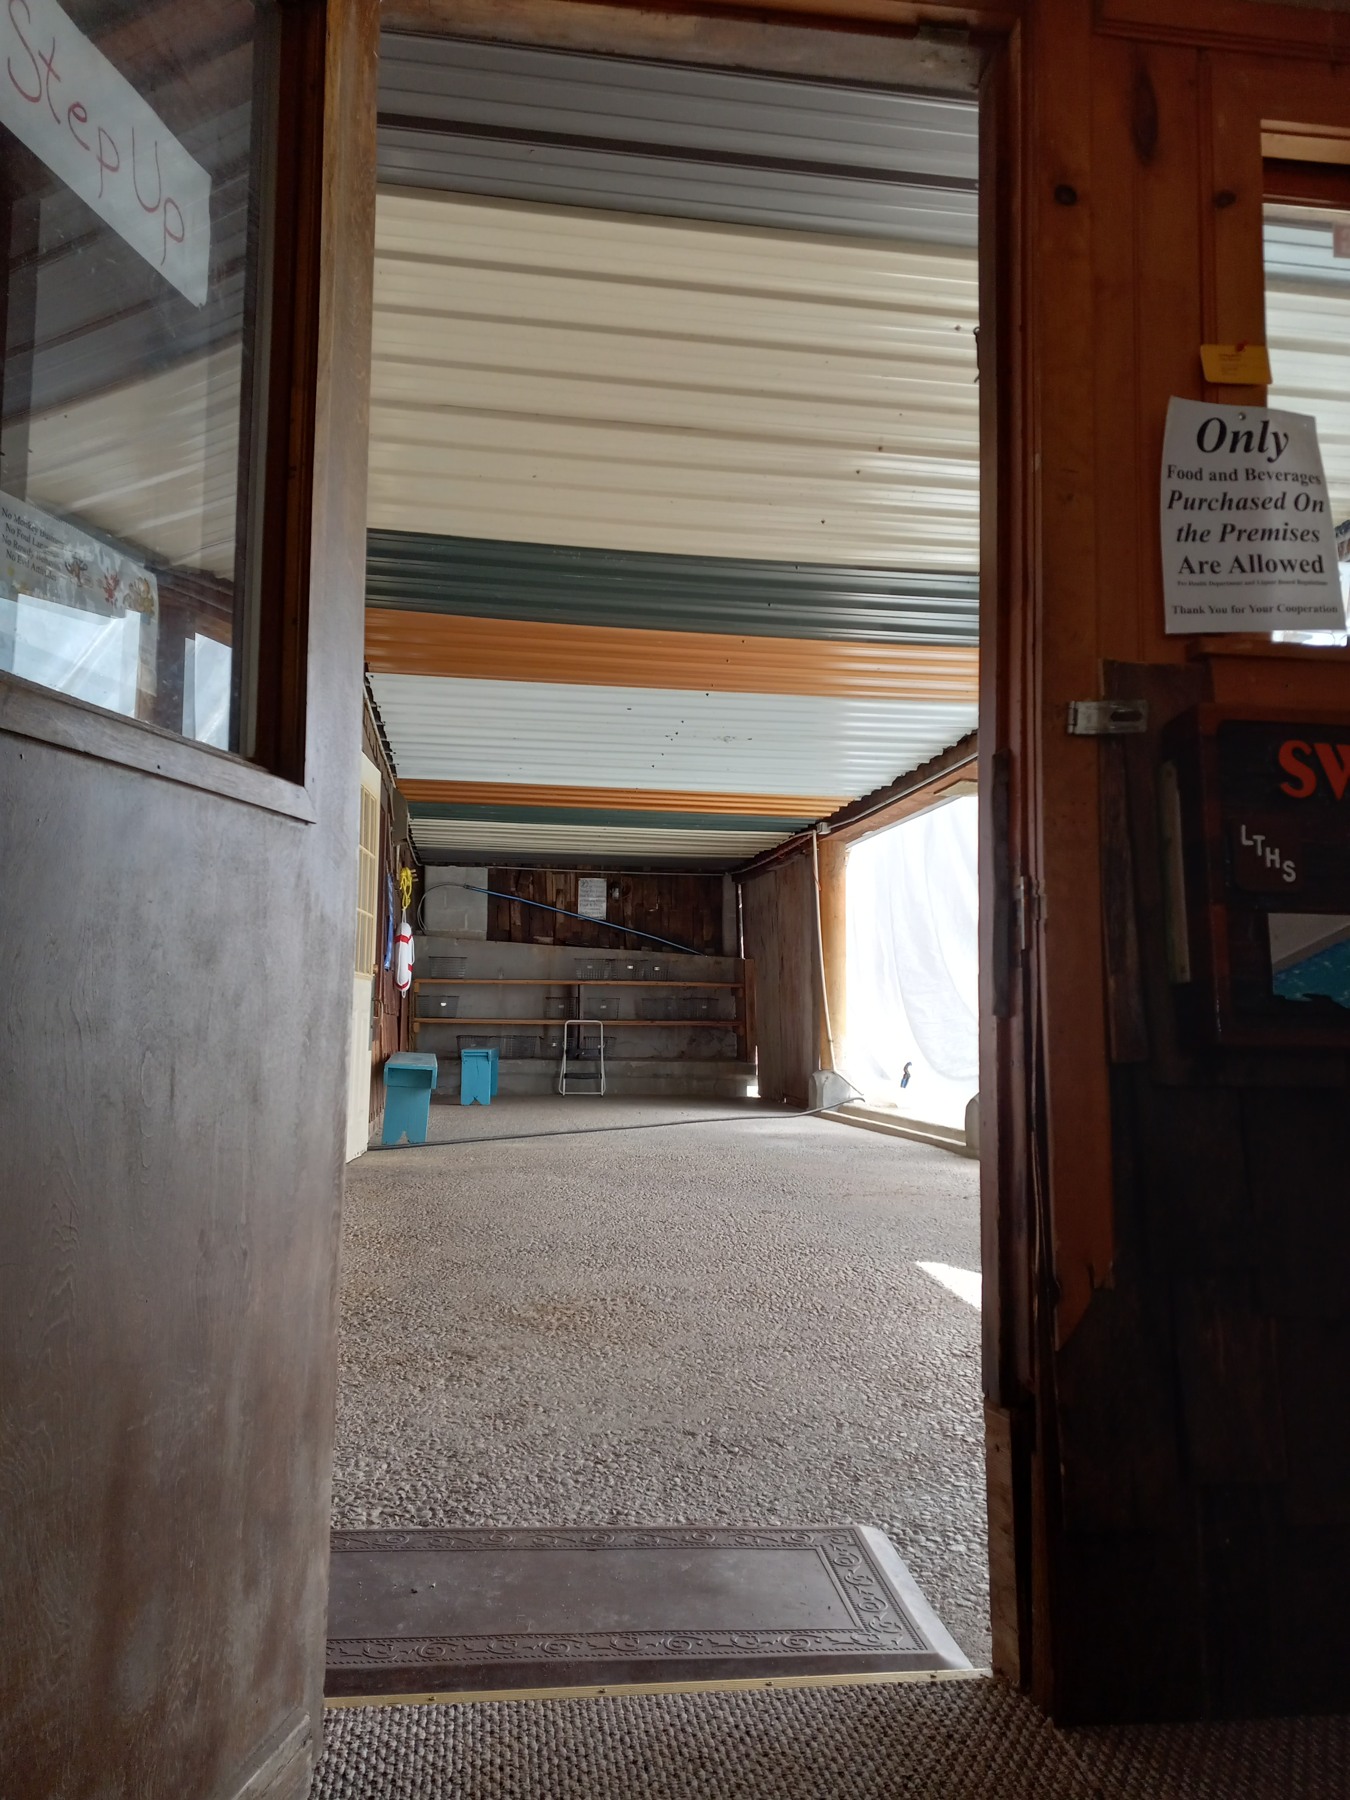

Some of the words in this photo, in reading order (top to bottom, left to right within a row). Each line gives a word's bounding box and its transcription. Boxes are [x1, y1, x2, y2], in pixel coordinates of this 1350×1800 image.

[8, 0, 120, 199] Step
[131, 126, 185, 266] Up
[1196, 416, 1289, 463] Only
[1166, 464, 1203, 481] Food
[1208, 468, 1238, 482] and
[1245, 467, 1321, 487] Beverages
[1167, 489, 1287, 511] Purchased
[1293, 492, 1324, 513] On
[2, 507, 12, 519] No
[5, 522, 16, 535] No
[1176, 523, 1211, 543] the
[1219, 522, 1320, 543] Premises
[2, 533, 12, 546] No
[6, 549, 16, 561] No
[1177, 555, 1221, 574] Are
[1228, 553, 1325, 574] Allowed
[1172, 604, 1205, 615] Thank
[1208, 605, 1228, 615] You
[1231, 604, 1246, 614] for
[1249, 604, 1274, 614] Your
[1276, 603, 1338, 616] Cooperation
[1240, 824, 1297, 883] LTHS
